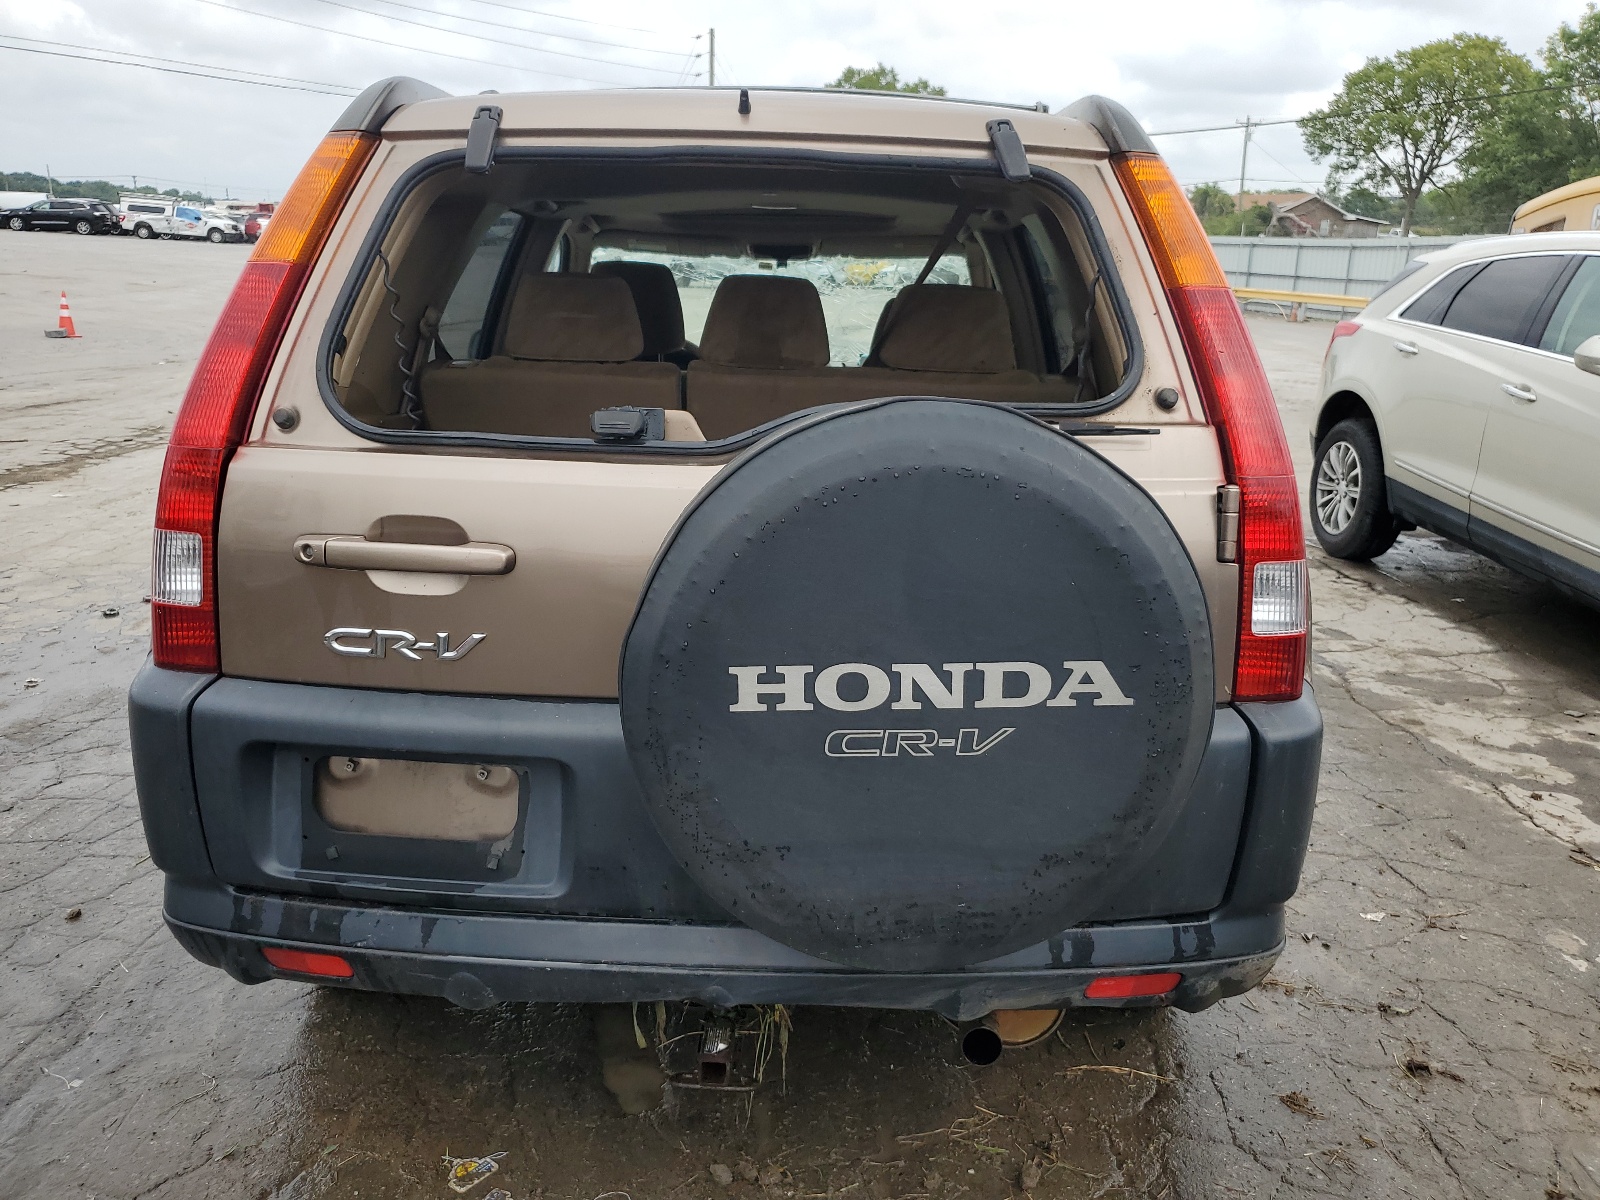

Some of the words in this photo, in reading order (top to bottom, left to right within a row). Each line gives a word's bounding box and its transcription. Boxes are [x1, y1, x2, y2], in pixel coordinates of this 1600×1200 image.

[324, 627, 485, 661] CR-V
[728, 660, 1134, 713] HONDA
[824, 727, 1015, 758] CR-V
